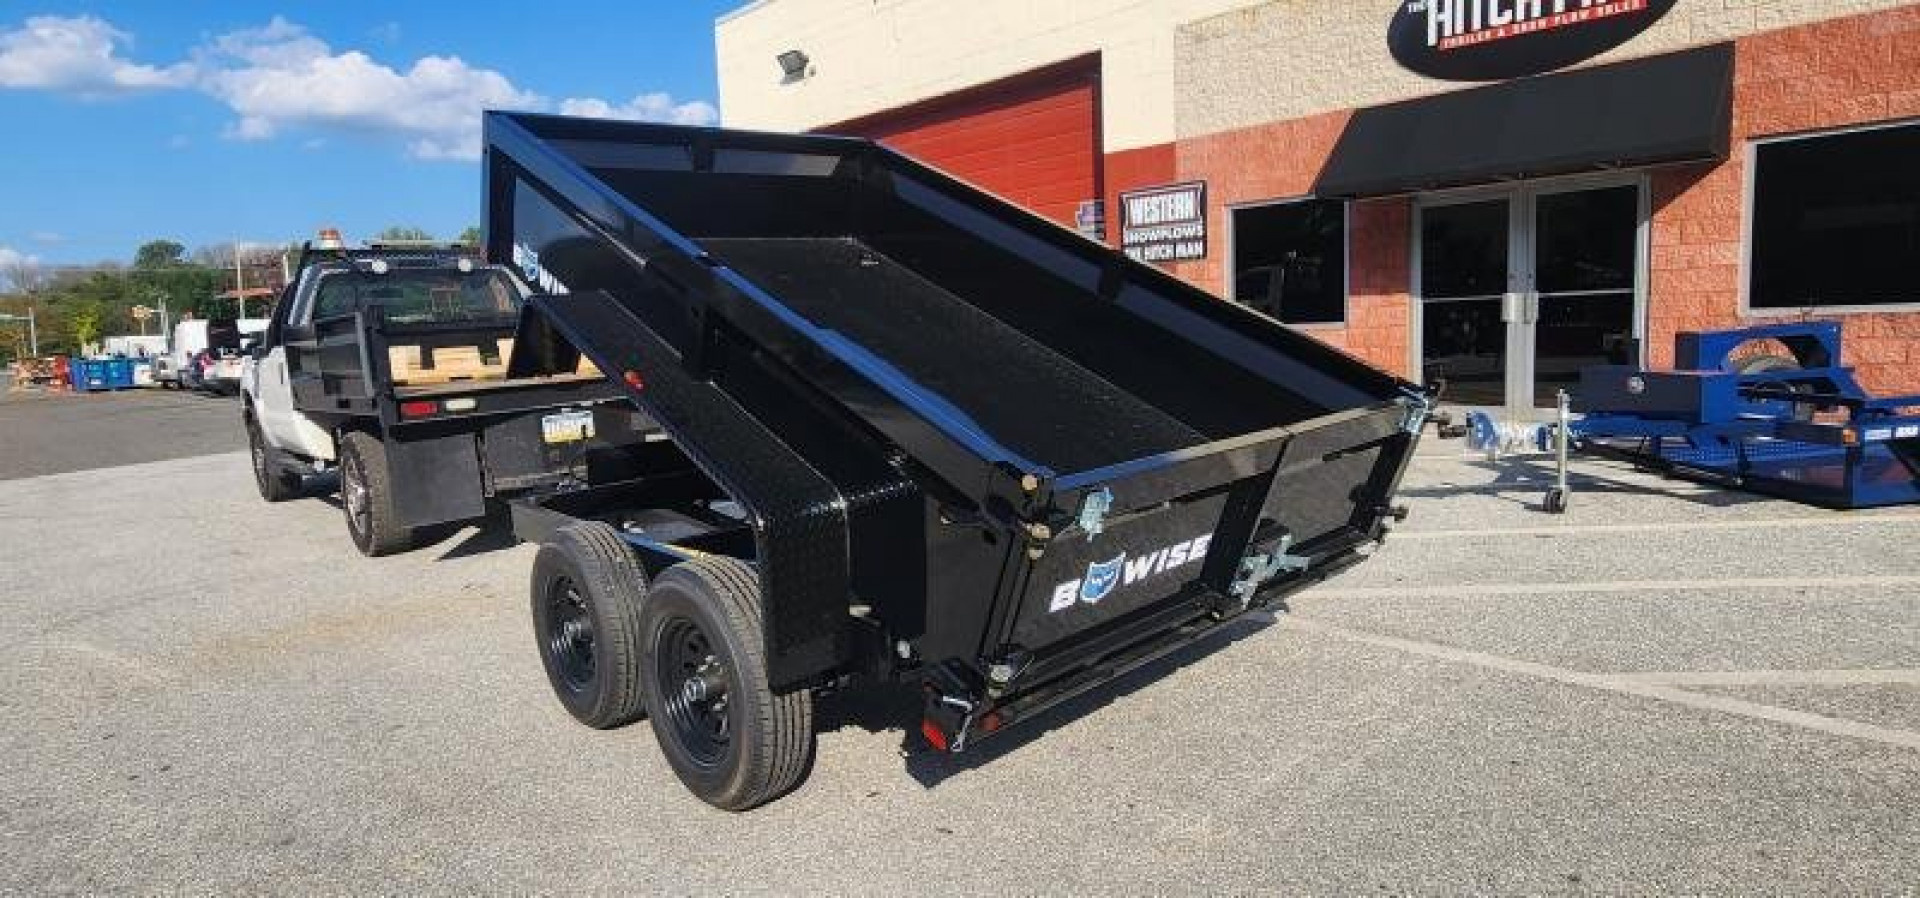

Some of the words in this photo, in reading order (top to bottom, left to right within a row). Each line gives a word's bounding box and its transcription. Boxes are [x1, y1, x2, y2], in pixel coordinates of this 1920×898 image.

[1128, 190, 1195, 227] WESTERN
[1123, 222, 1202, 245] SNOWPLOWS
[1144, 243, 1174, 261] HITCH
[1176, 240, 1203, 258] MAN
